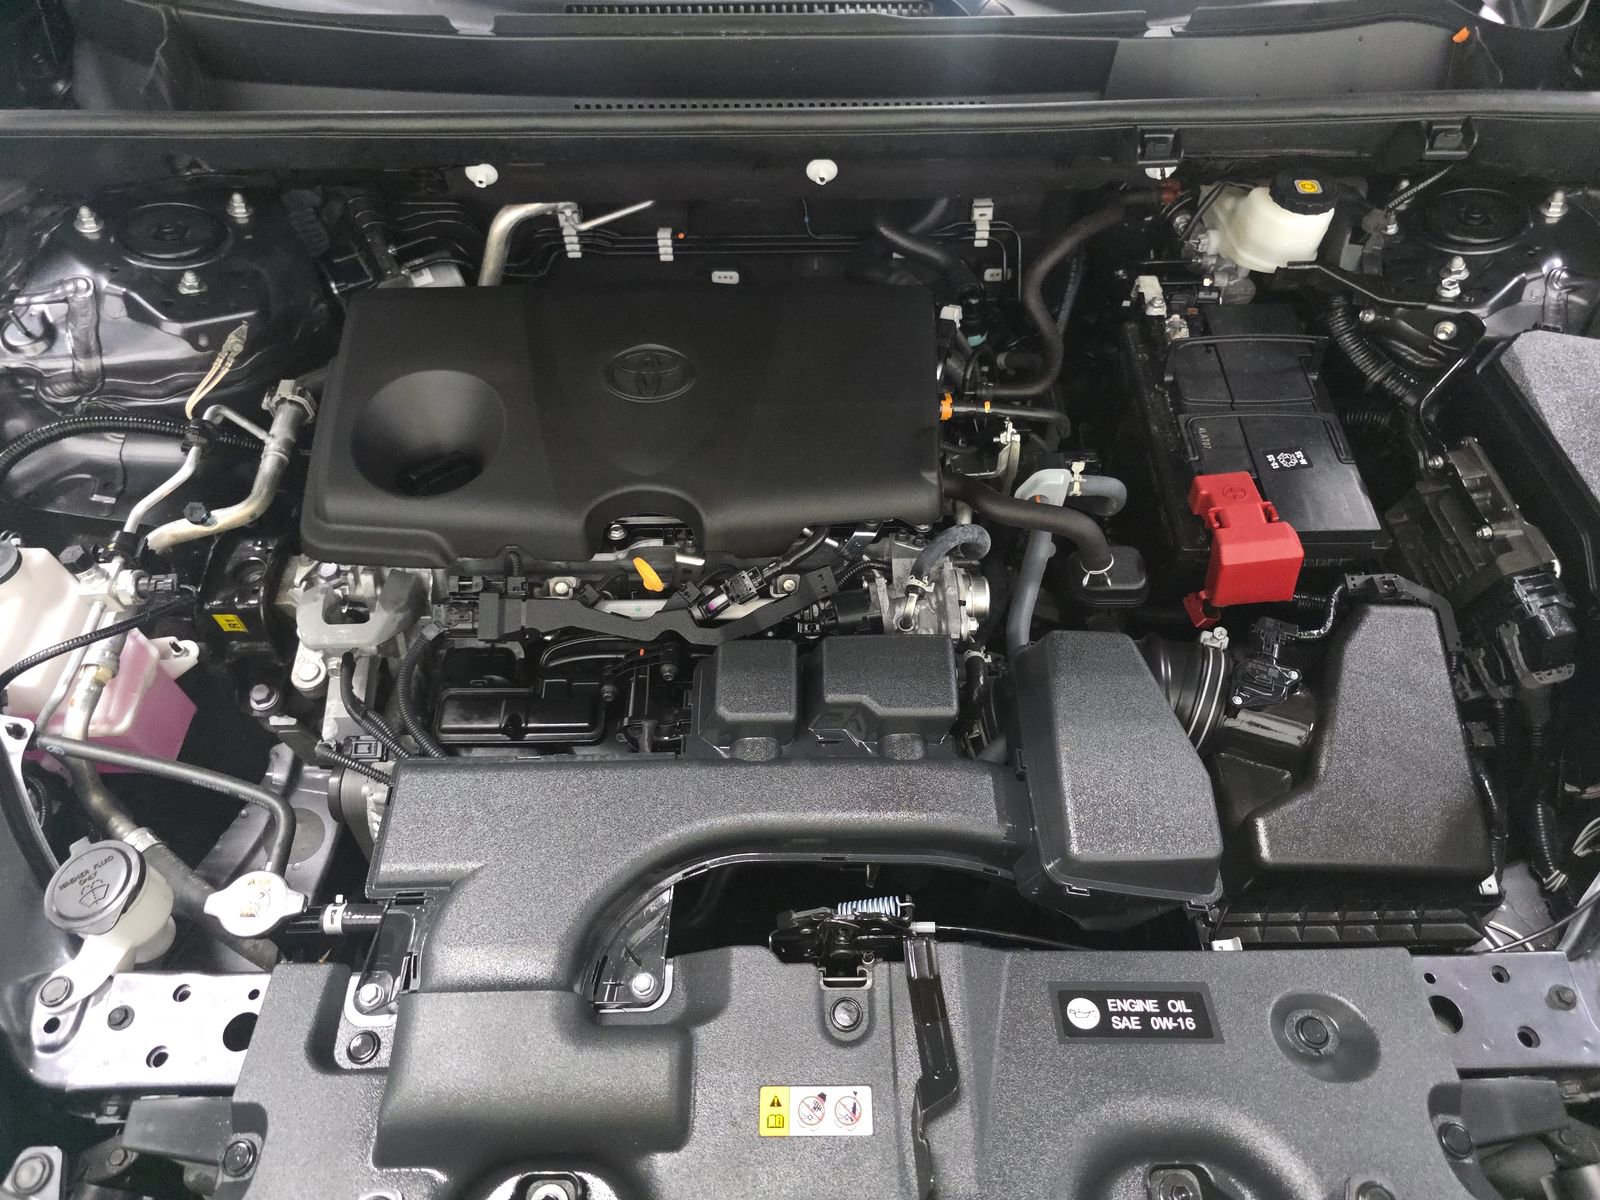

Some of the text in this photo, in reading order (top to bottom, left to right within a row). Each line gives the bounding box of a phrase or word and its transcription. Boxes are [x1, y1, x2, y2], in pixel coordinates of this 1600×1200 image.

[93, 855, 114, 870] FLUID
[1106, 998, 1193, 1013] ENGINE OIL
[1111, 1015, 1196, 1031] SAE 0W-16
